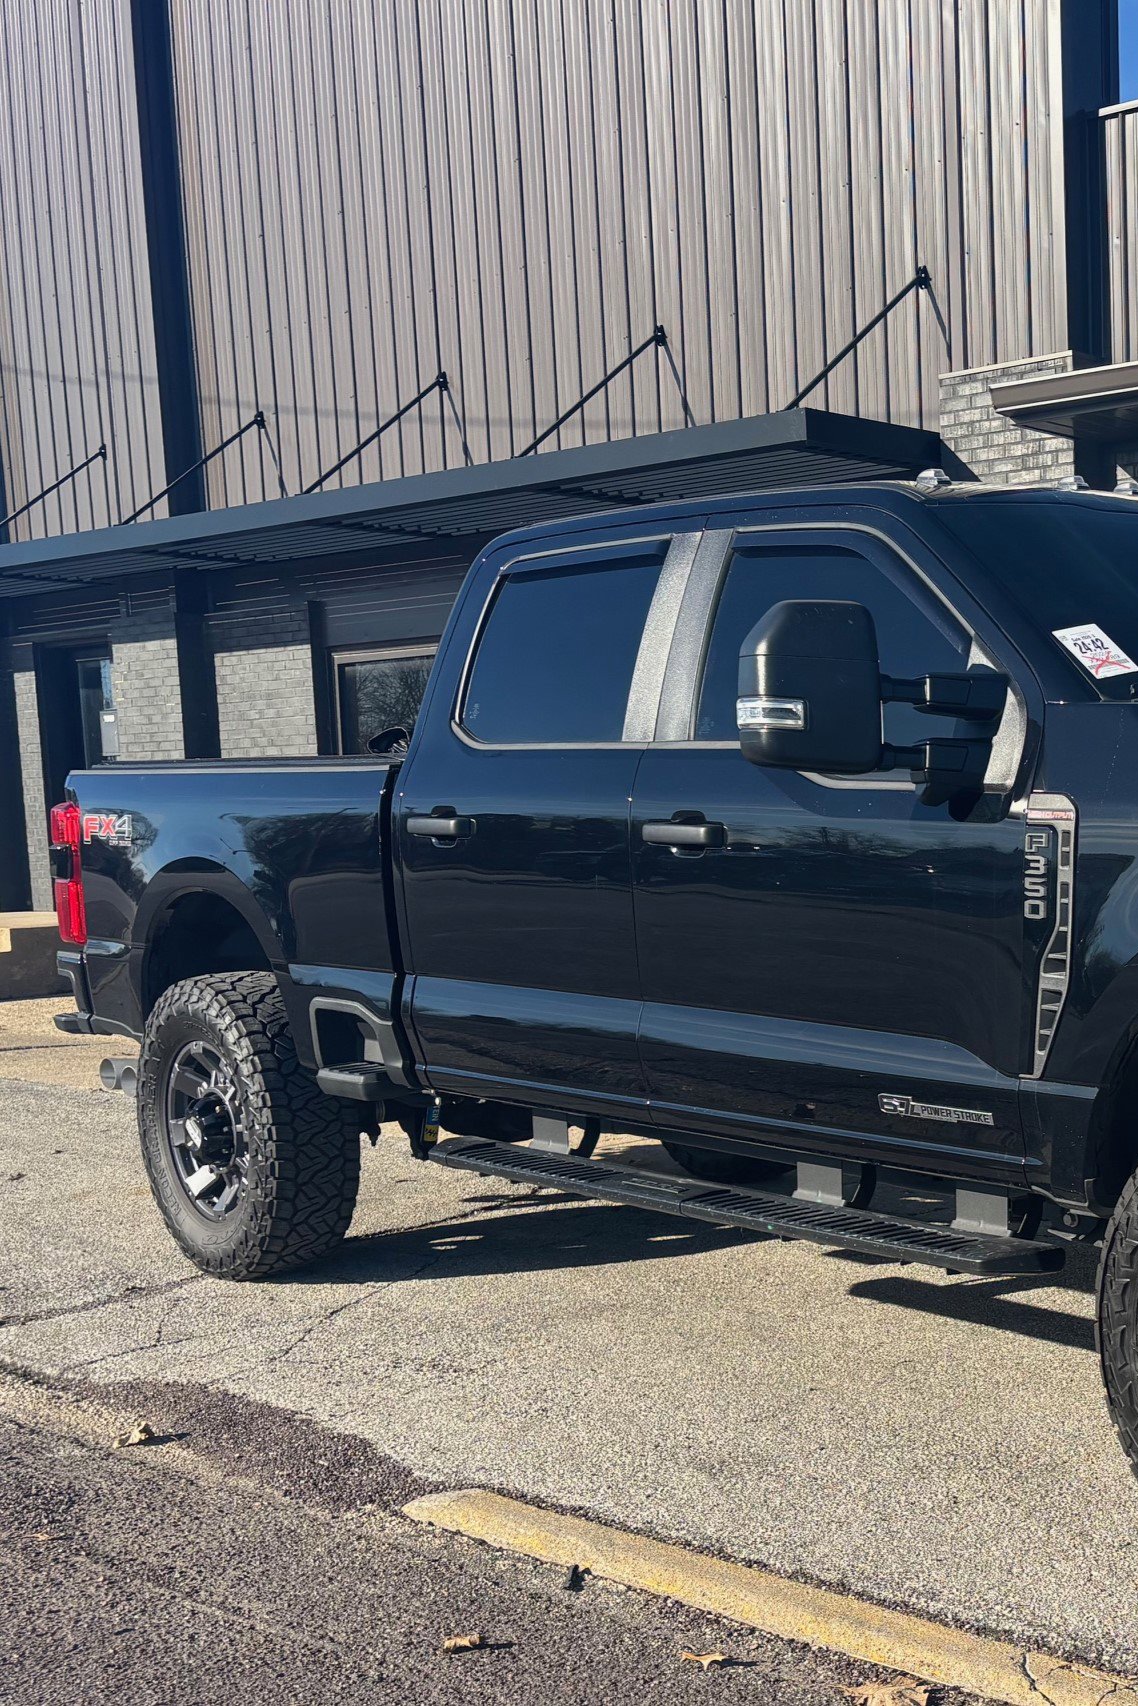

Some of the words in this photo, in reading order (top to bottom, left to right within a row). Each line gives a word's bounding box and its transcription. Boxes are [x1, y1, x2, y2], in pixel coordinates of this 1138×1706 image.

[1074, 638, 1109, 654] 24:42
[83, 814, 132, 844] FX4
[920, 1105, 952, 1119] POWER
[953, 1110, 991, 1124] STROKE
